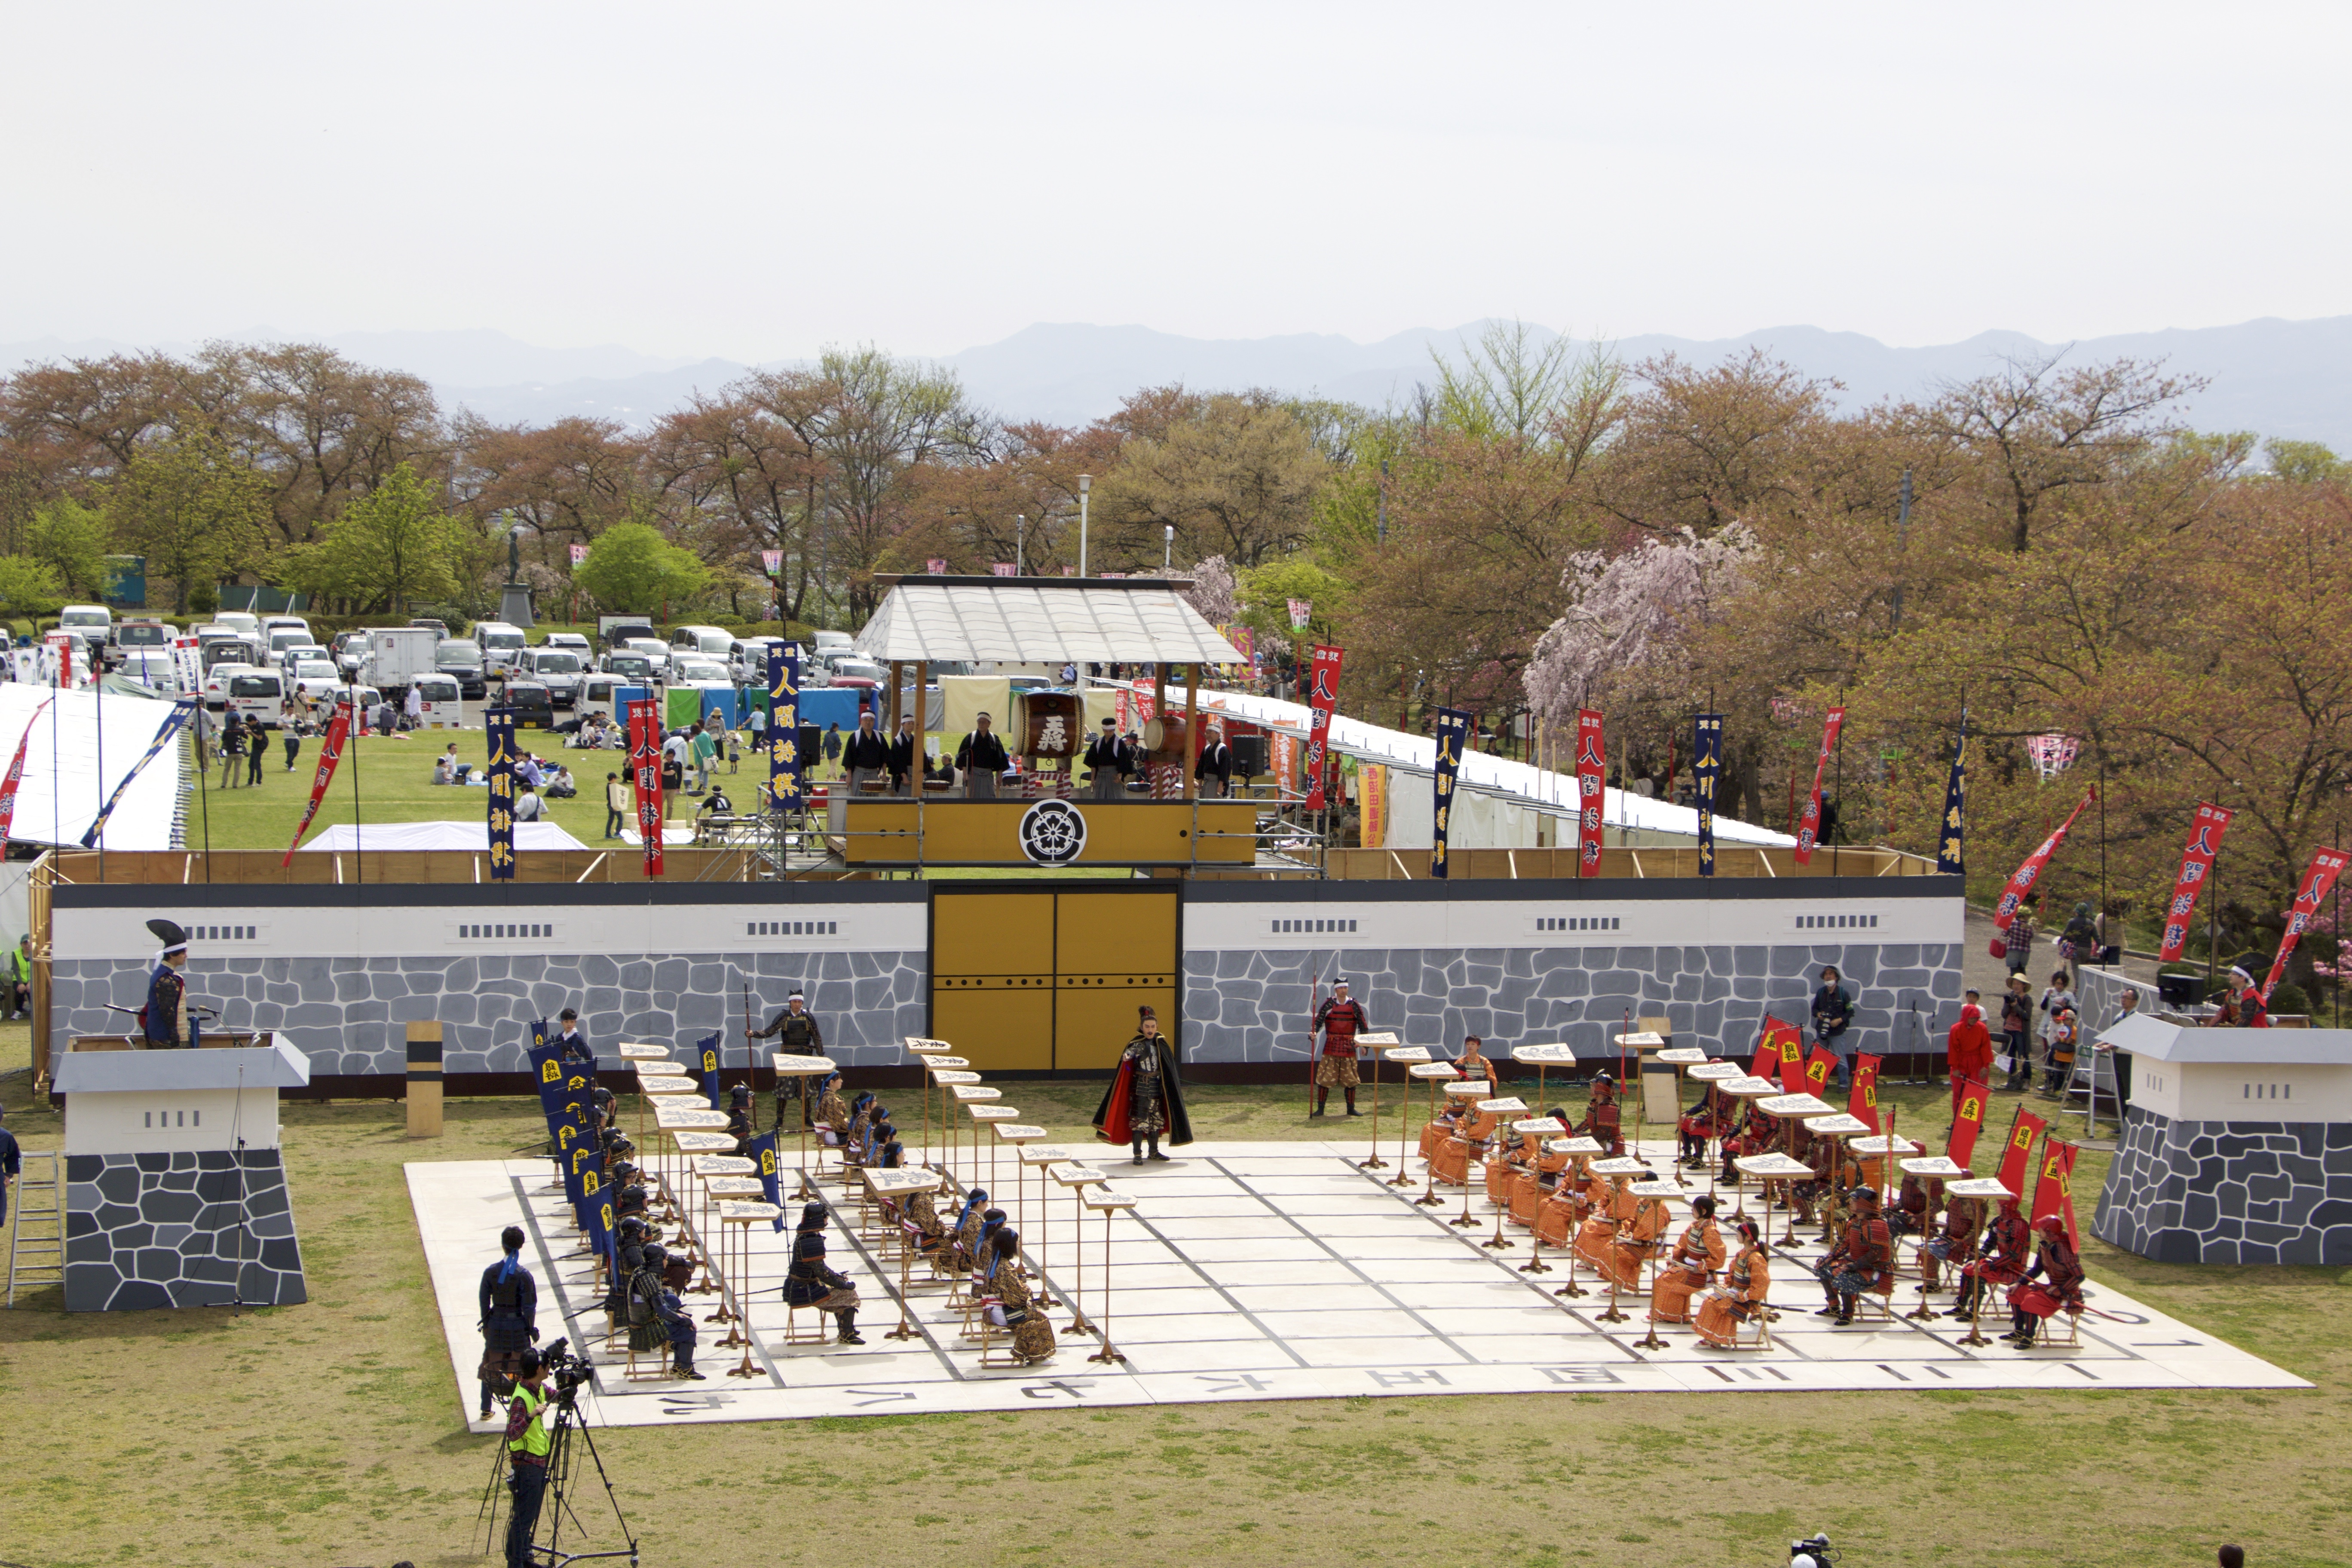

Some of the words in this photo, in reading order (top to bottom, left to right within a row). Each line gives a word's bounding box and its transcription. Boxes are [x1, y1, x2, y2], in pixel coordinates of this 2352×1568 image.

[772, 647, 795, 658] 天童
[632, 707, 653, 717] 天童
[489, 715, 512, 725] 天童
[1699, 720, 1720, 730] 天童
[769, 666, 799, 799] 人間将棋
[1037, 715, 1068, 752] 王将
[489, 733, 514, 867] 人間将棋
[1516, 1046, 1570, 1059] 飛車
[640, 1063, 681, 1072] 桂馬
[1810, 1063, 1823, 1080] 桂馬
[1963, 1098, 1978, 1118] 金将
[679, 1133, 732, 1147] 金将
[2016, 1127, 2030, 1148] 銀将
[712, 1179, 760, 1190] 桂馬
[872, 1170, 936, 1187] 飛車
[723, 1202, 775, 1215] 香車
[1364, 1369, 1453, 1389] 五
[1531, 1366, 1626, 1385] 四
